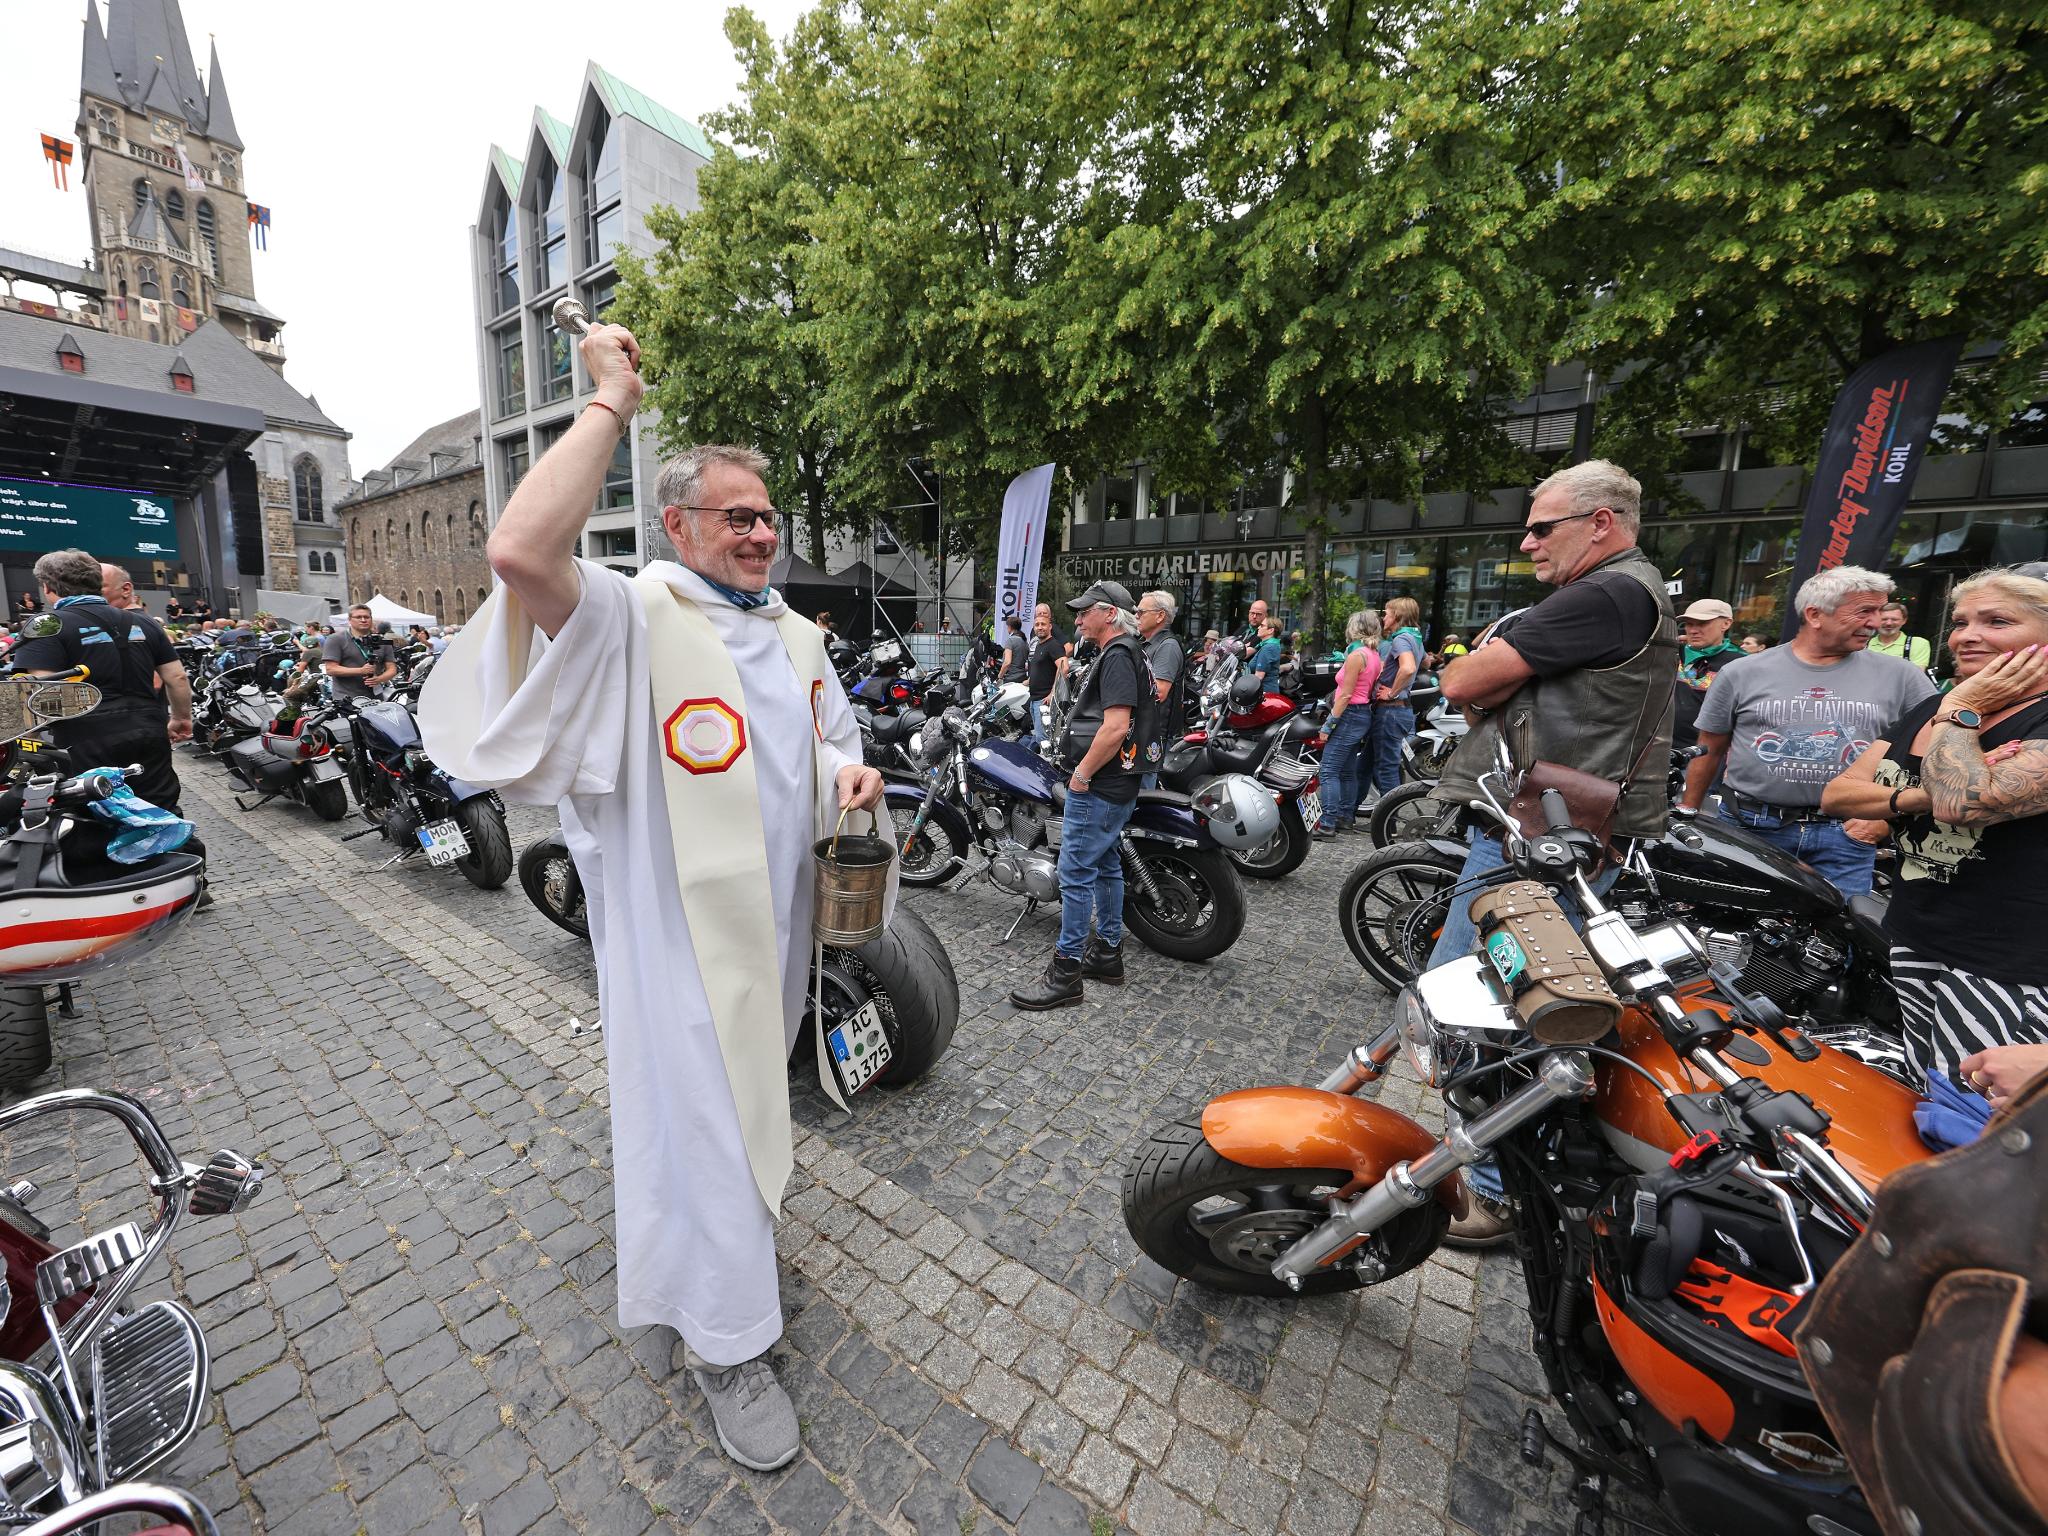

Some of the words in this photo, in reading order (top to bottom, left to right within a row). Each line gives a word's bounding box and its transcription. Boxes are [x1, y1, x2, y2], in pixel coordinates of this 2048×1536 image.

[1883, 443, 1912, 483] KOHL
[1064, 557, 1123, 577] CENTRE
[1128, 550, 1305, 575] CHARLEMAGNE
[1002, 563, 1019, 621] KOHL
[1155, 577, 1190, 587] Aachen
[1022, 581, 1034, 623] Motorrad
[430, 822, 458, 839] MON
[452, 843, 468, 858] 13
[851, 1009, 872, 1038] AC
[850, 1069, 861, 1090] J
[860, 1042, 890, 1079] 375
